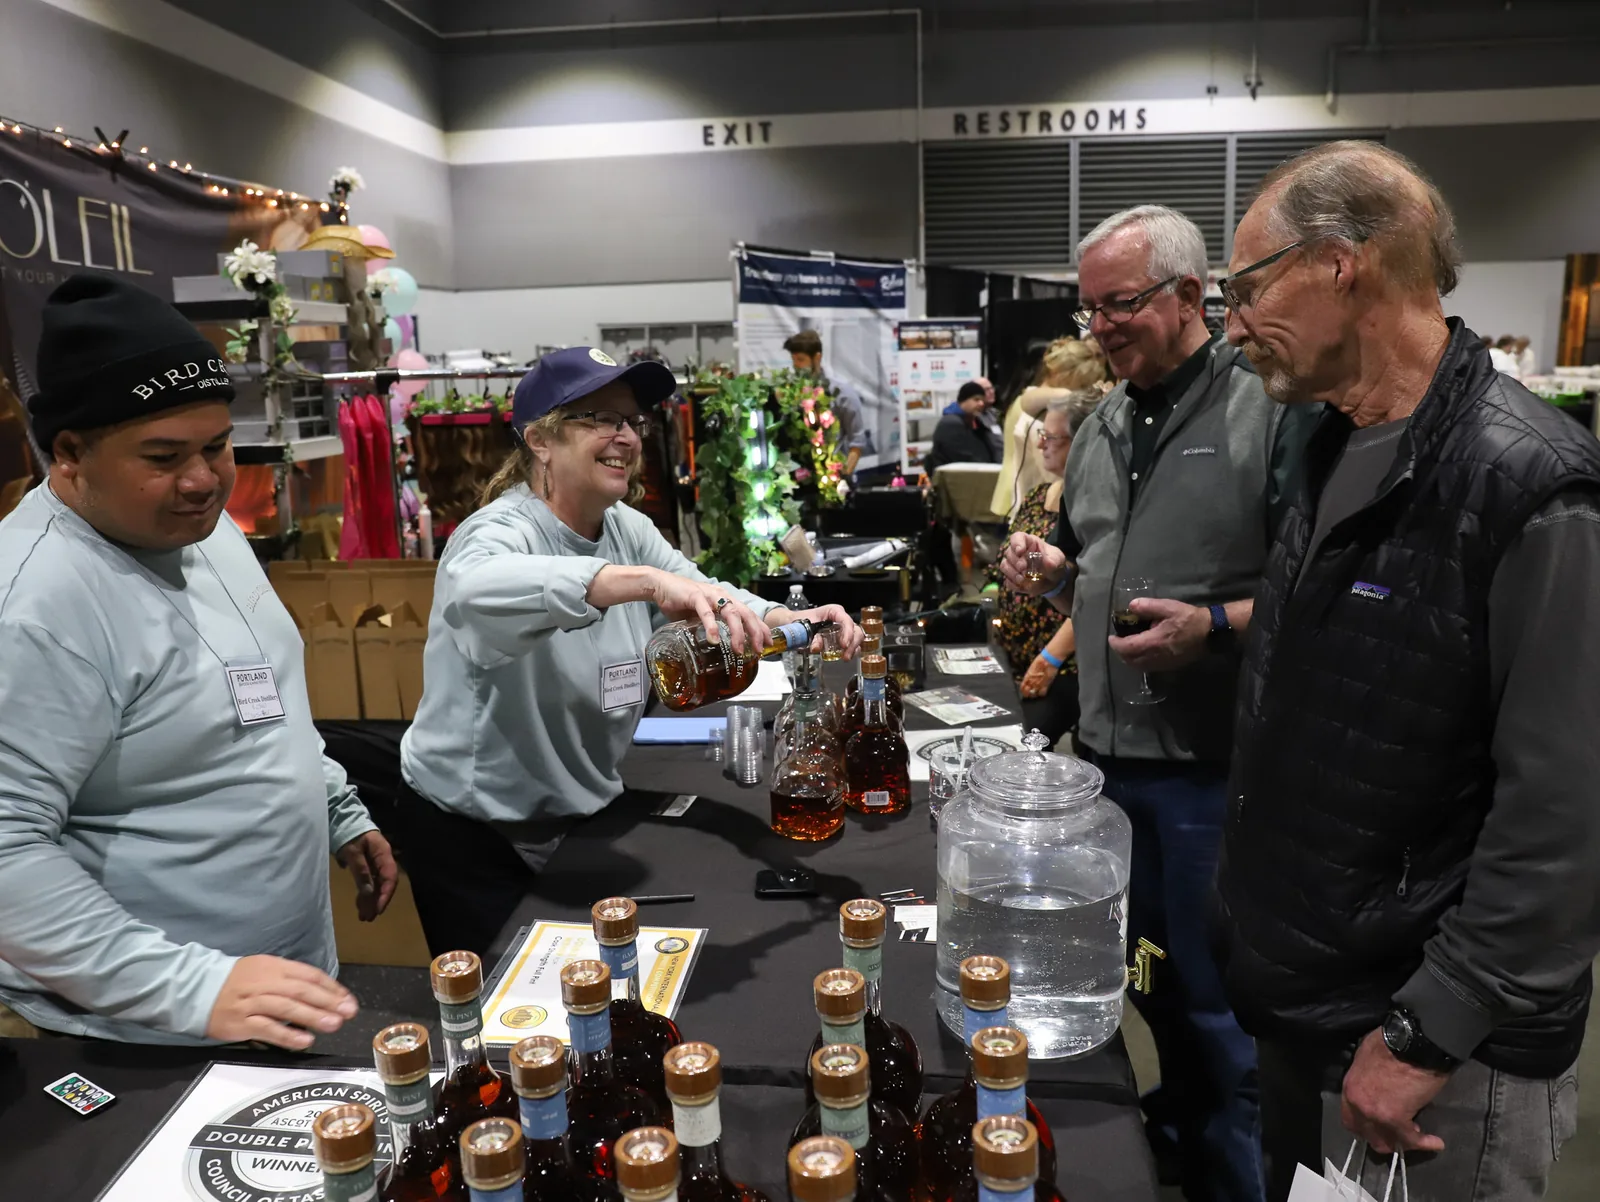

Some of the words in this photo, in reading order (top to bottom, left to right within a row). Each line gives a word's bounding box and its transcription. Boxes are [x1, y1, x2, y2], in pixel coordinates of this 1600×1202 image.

[953, 108, 1147, 135] RESTROOMS
[702, 121, 772, 147] EXIT
[131, 362, 200, 400] BIRD
[1351, 588, 1384, 600] patagonia
[236, 671, 268, 683] PORTLAND
[608, 666, 638, 678] PORTLAND
[252, 1087, 349, 1118] AMERICAN
[349, 1090, 390, 1125] SPIRITS
[205, 1131, 294, 1148] DOUBLE
[251, 1157, 321, 1173] WINNE
